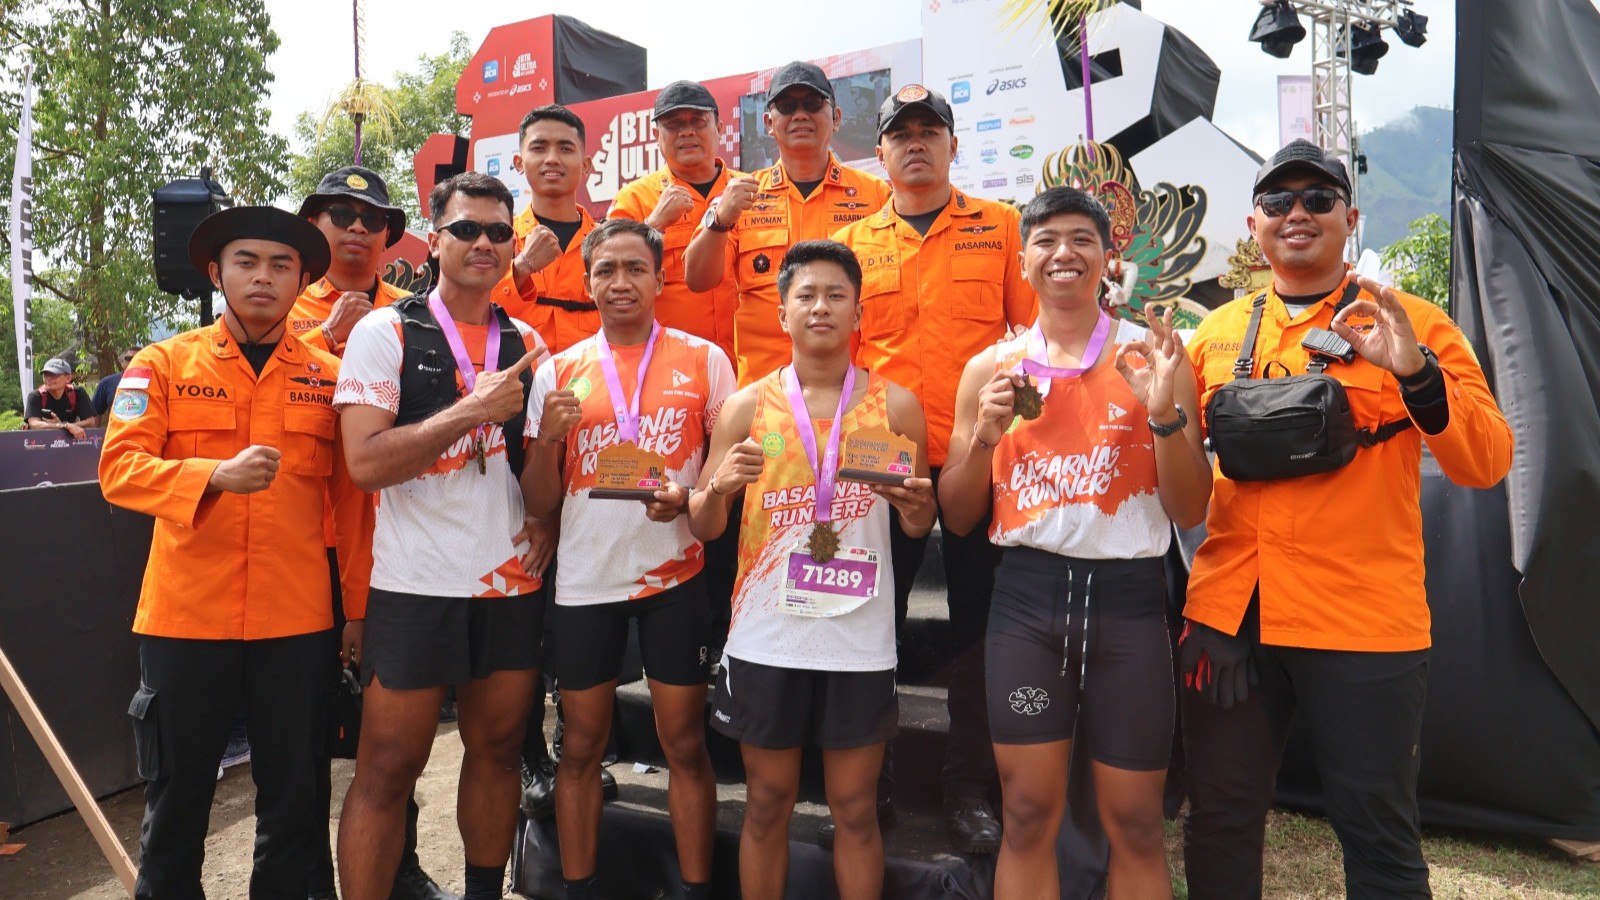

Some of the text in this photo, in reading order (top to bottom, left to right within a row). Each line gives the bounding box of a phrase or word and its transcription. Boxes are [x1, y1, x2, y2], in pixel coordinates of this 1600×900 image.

[999, 77, 1027, 91] asics
[751, 216, 783, 226] NYOMAN
[955, 240, 1003, 251] BASARNAS
[175, 384, 228, 399] YOGA
[290, 391, 334, 405] BASARNA
[1010, 445, 1121, 491] BASARNAS
[762, 481, 873, 510] BASANAS
[1017, 470, 1113, 511] RUNNERS
[770, 499, 872, 528] RUNERS
[802, 564, 863, 589] 71289
